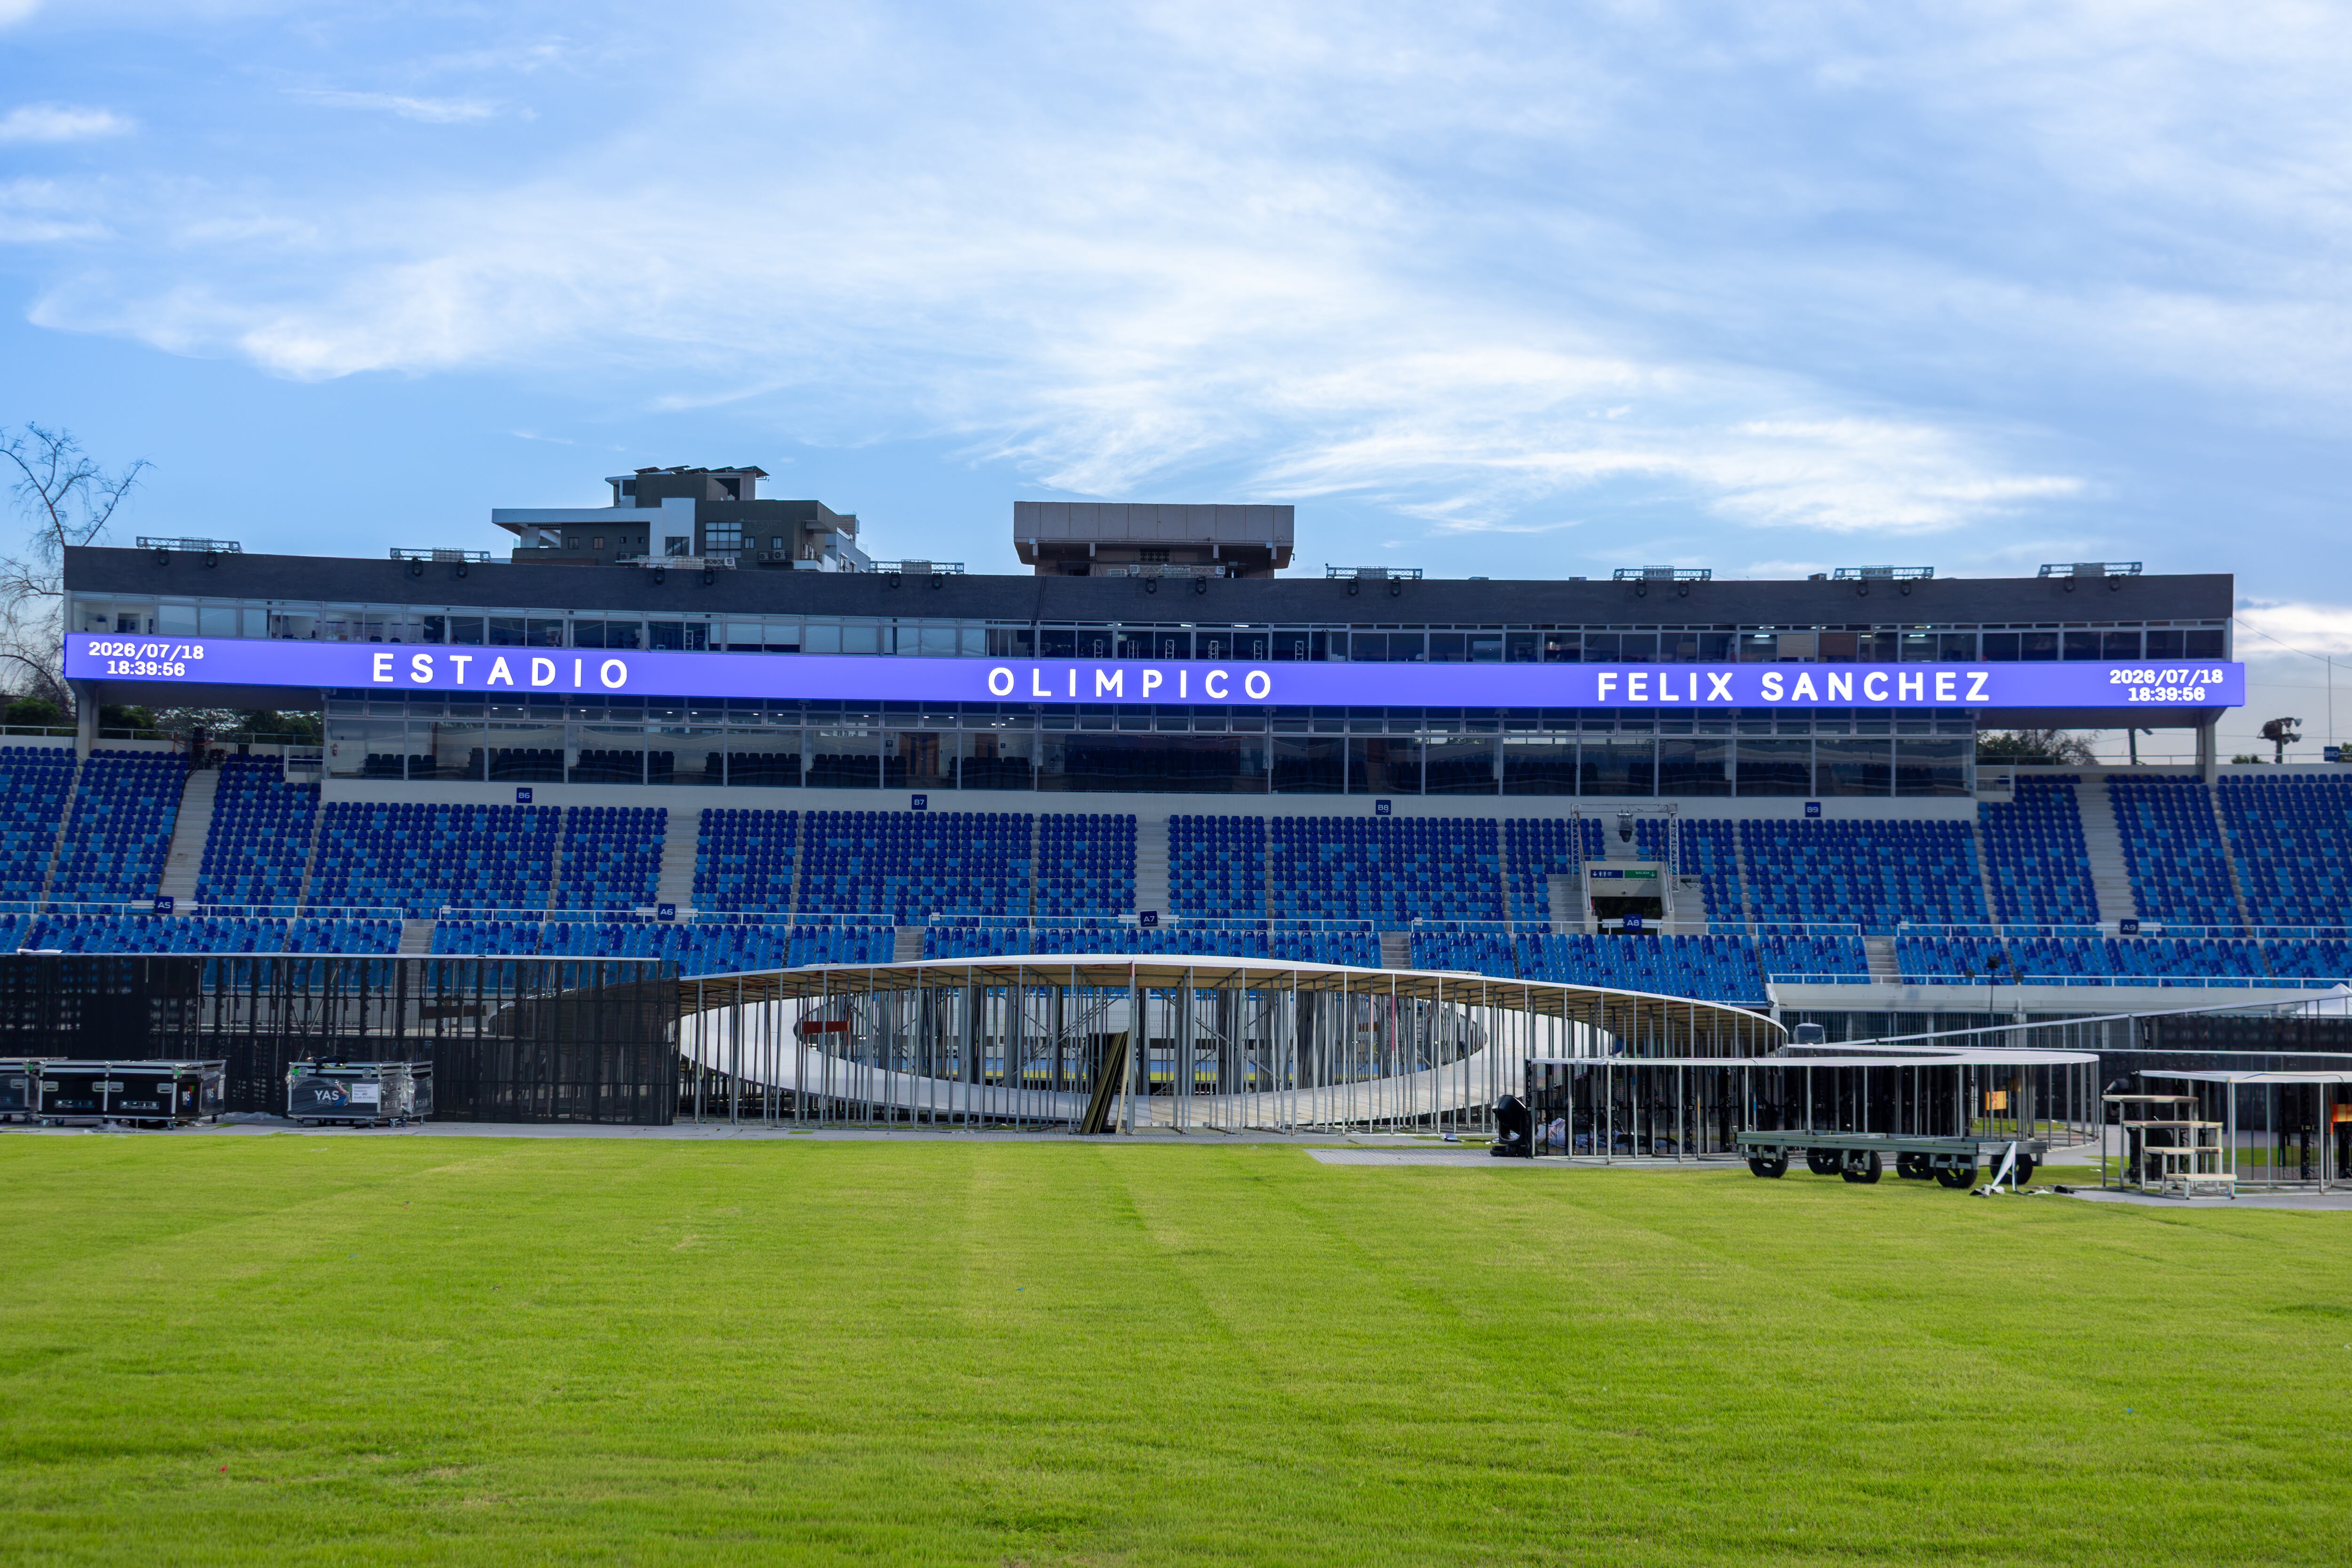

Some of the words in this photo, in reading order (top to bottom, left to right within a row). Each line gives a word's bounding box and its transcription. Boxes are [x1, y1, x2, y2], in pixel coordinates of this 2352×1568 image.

[89, 642, 204, 661] 2026/07/18
[107, 660, 185, 677] 18:39:56
[373, 653, 628, 688] ESTADIO
[988, 668, 1271, 699] OLIMPICO
[1598, 673, 1733, 701] FELIX
[1761, 672, 1990, 701] SANCHEZ
[2109, 669, 2224, 686] 2026/07/18
[2128, 687, 2206, 701] 18:39:56
[314, 1090, 339, 1100] YAS
